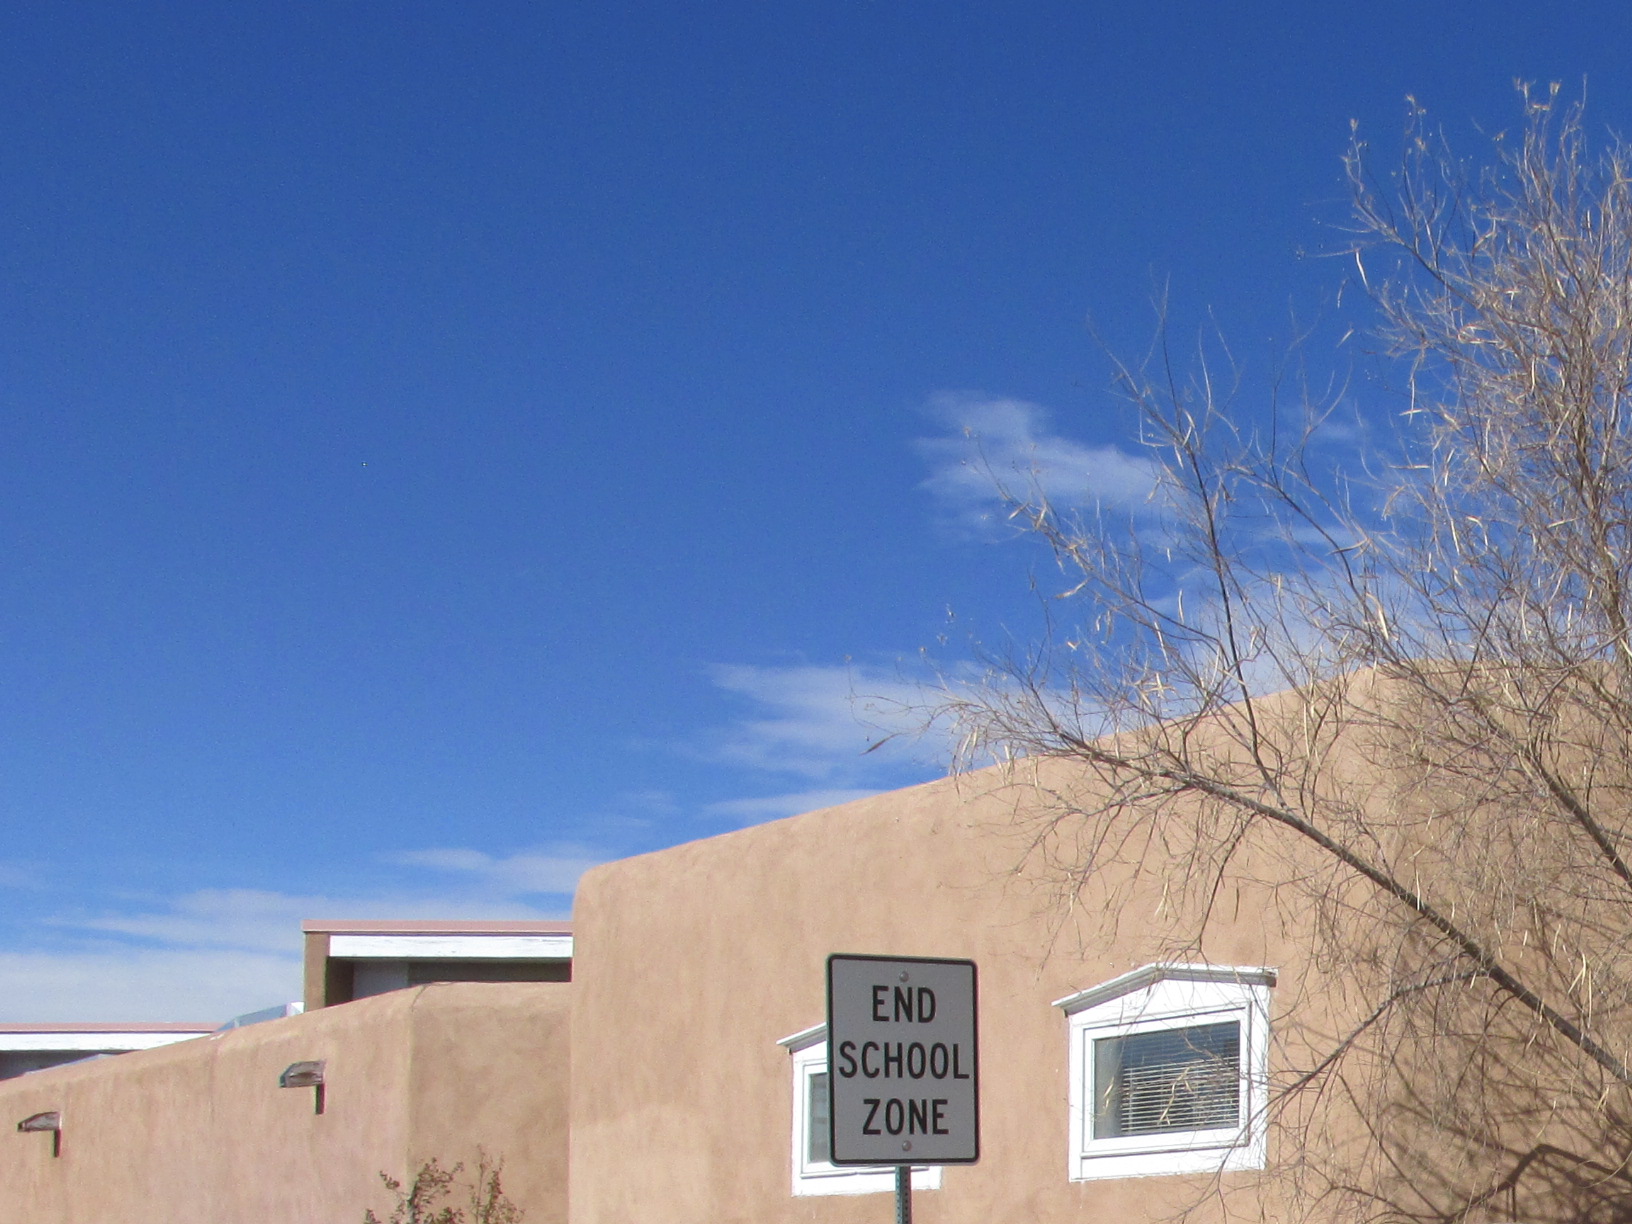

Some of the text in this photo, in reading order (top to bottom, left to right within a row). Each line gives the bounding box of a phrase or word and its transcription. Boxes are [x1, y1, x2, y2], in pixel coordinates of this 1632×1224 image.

[872, 985, 936, 1023] END
[838, 1040, 970, 1080] SCHOOL
[862, 1098, 949, 1136] ZONE
